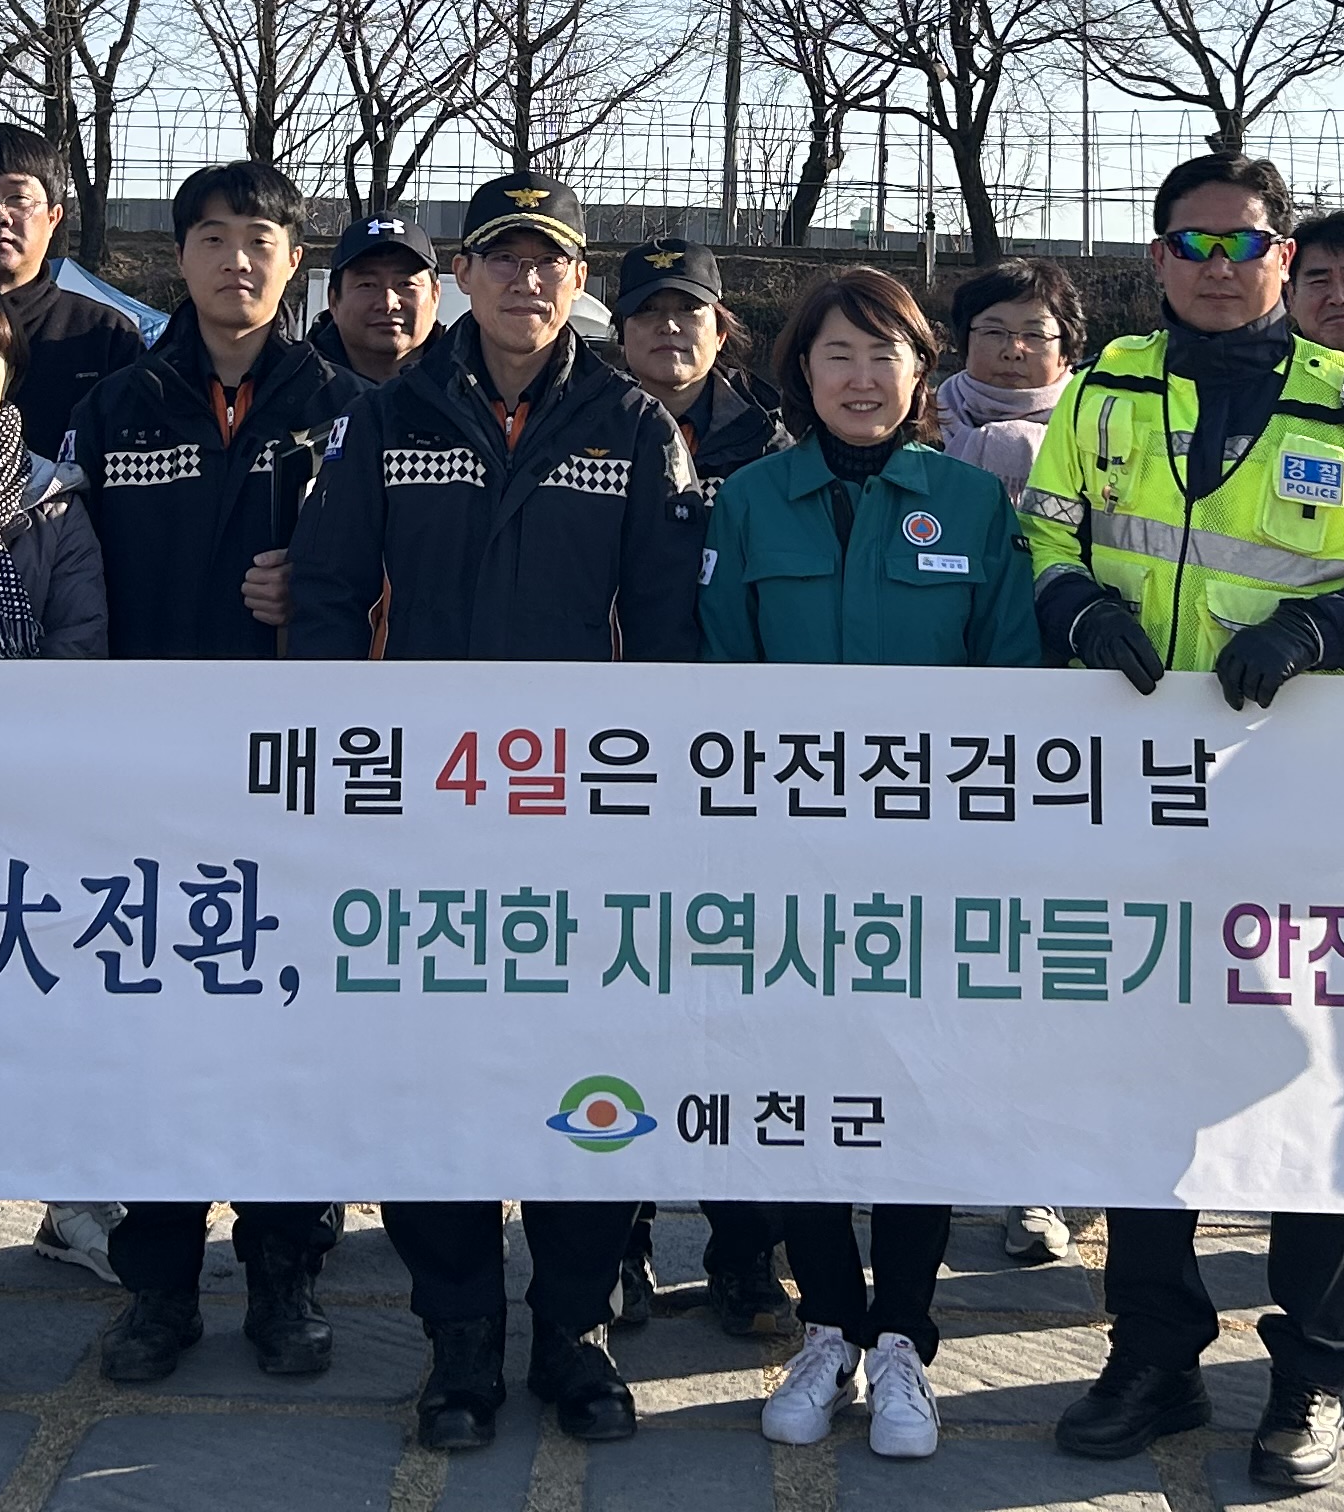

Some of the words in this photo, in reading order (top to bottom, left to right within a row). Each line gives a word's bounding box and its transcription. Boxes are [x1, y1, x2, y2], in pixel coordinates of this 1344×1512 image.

[1286, 483, 1338, 499] POLICE
[1287, 458, 1339, 485] 경찰
[249, 727, 404, 816] 매월
[435, 728, 658, 816] 4일은
[689, 730, 1103, 825] 안전점검의
[1142, 738, 1216, 828] 날
[332, 886, 578, 994] 안전한
[602, 891, 923, 999] 지역사회
[954, 897, 1193, 1005] 만들기
[677, 1090, 886, 1148] 예천군
